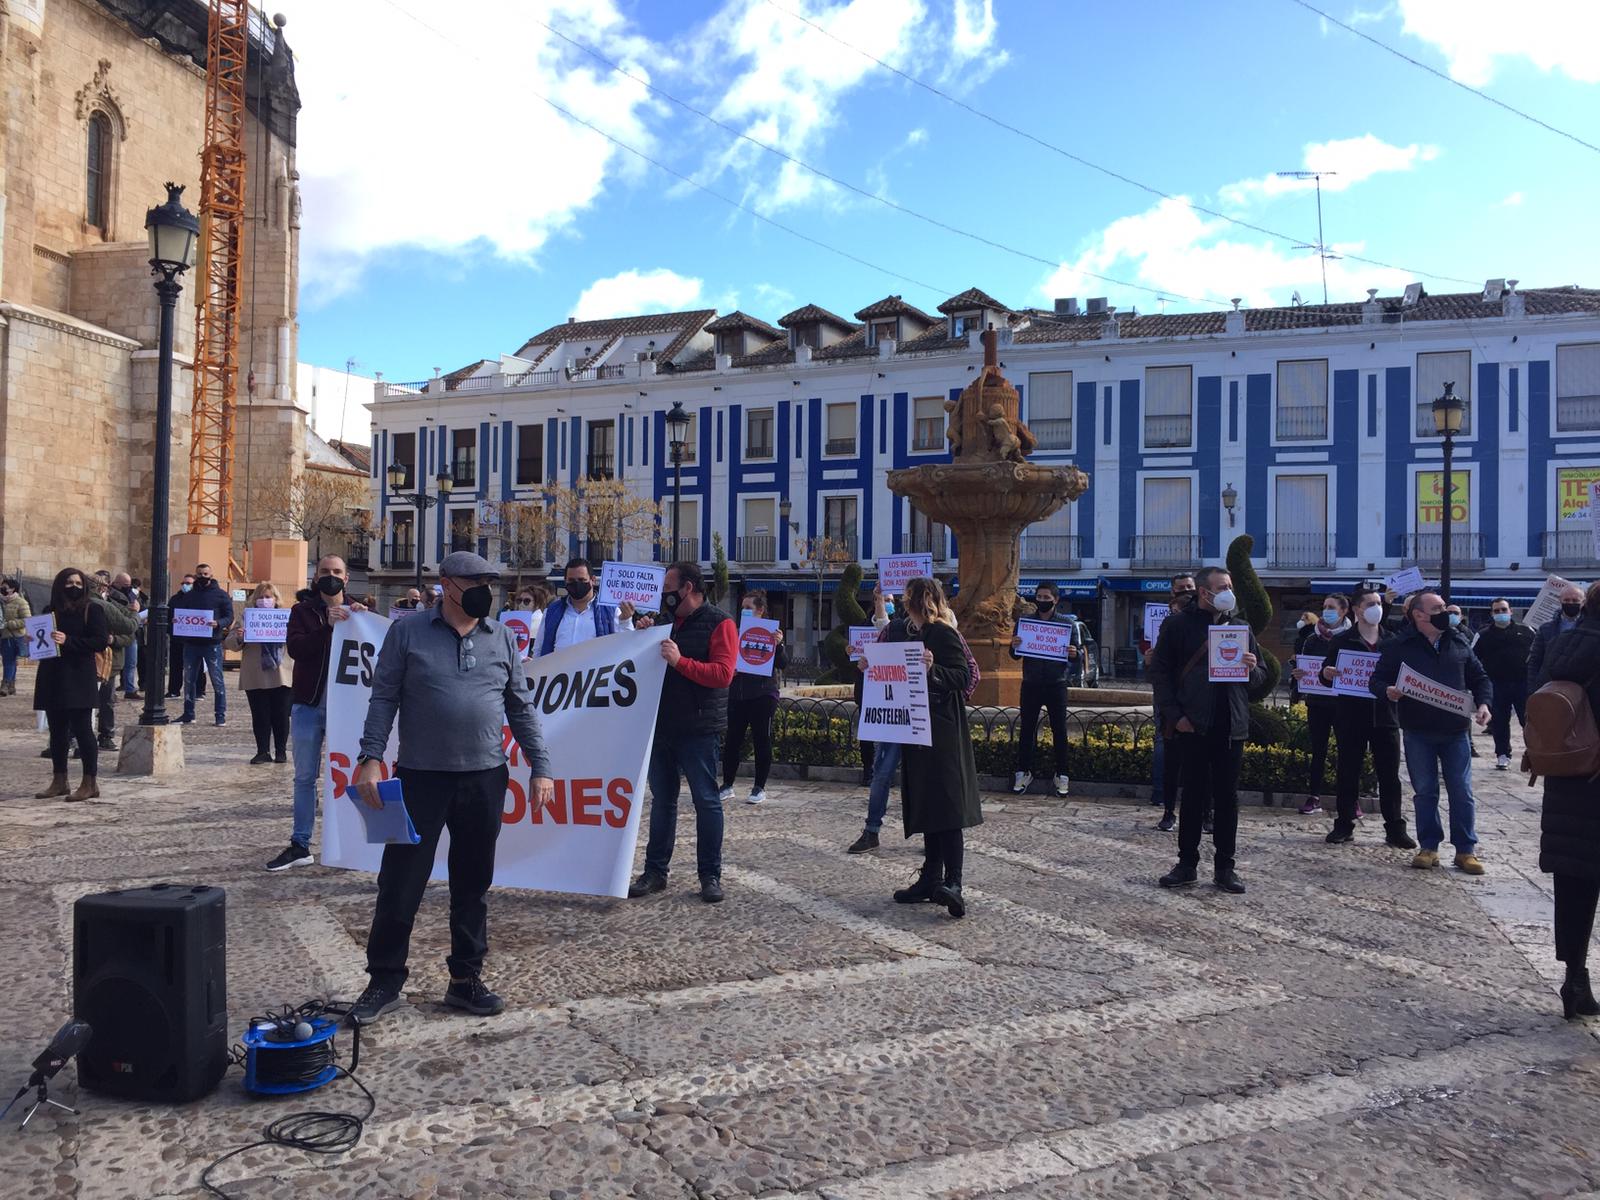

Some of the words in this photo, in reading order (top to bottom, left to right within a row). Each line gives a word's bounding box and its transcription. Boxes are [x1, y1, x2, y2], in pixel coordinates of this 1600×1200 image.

[1420, 505, 1467, 522] TEO
[889, 561, 899, 569] LOS
[618, 569, 635, 579] SOLO
[636, 571, 655, 581] FALTA
[606, 579, 620, 588] QUE
[621, 580, 635, 589] NOS
[636, 582, 659, 592] QUITEN
[185, 616, 206, 625] SOS
[1039, 626, 1068, 636] OPCIONES
[1045, 636, 1058, 644] SON
[867, 664, 908, 682] #SALVEMOS
[1343, 667, 1353, 675] NO
[1340, 677, 1354, 686] SON
[884, 684, 894, 701] LA
[1404, 674, 1465, 705] #SALVEMOS
[864, 706, 911, 726] HOSTELERÍA
